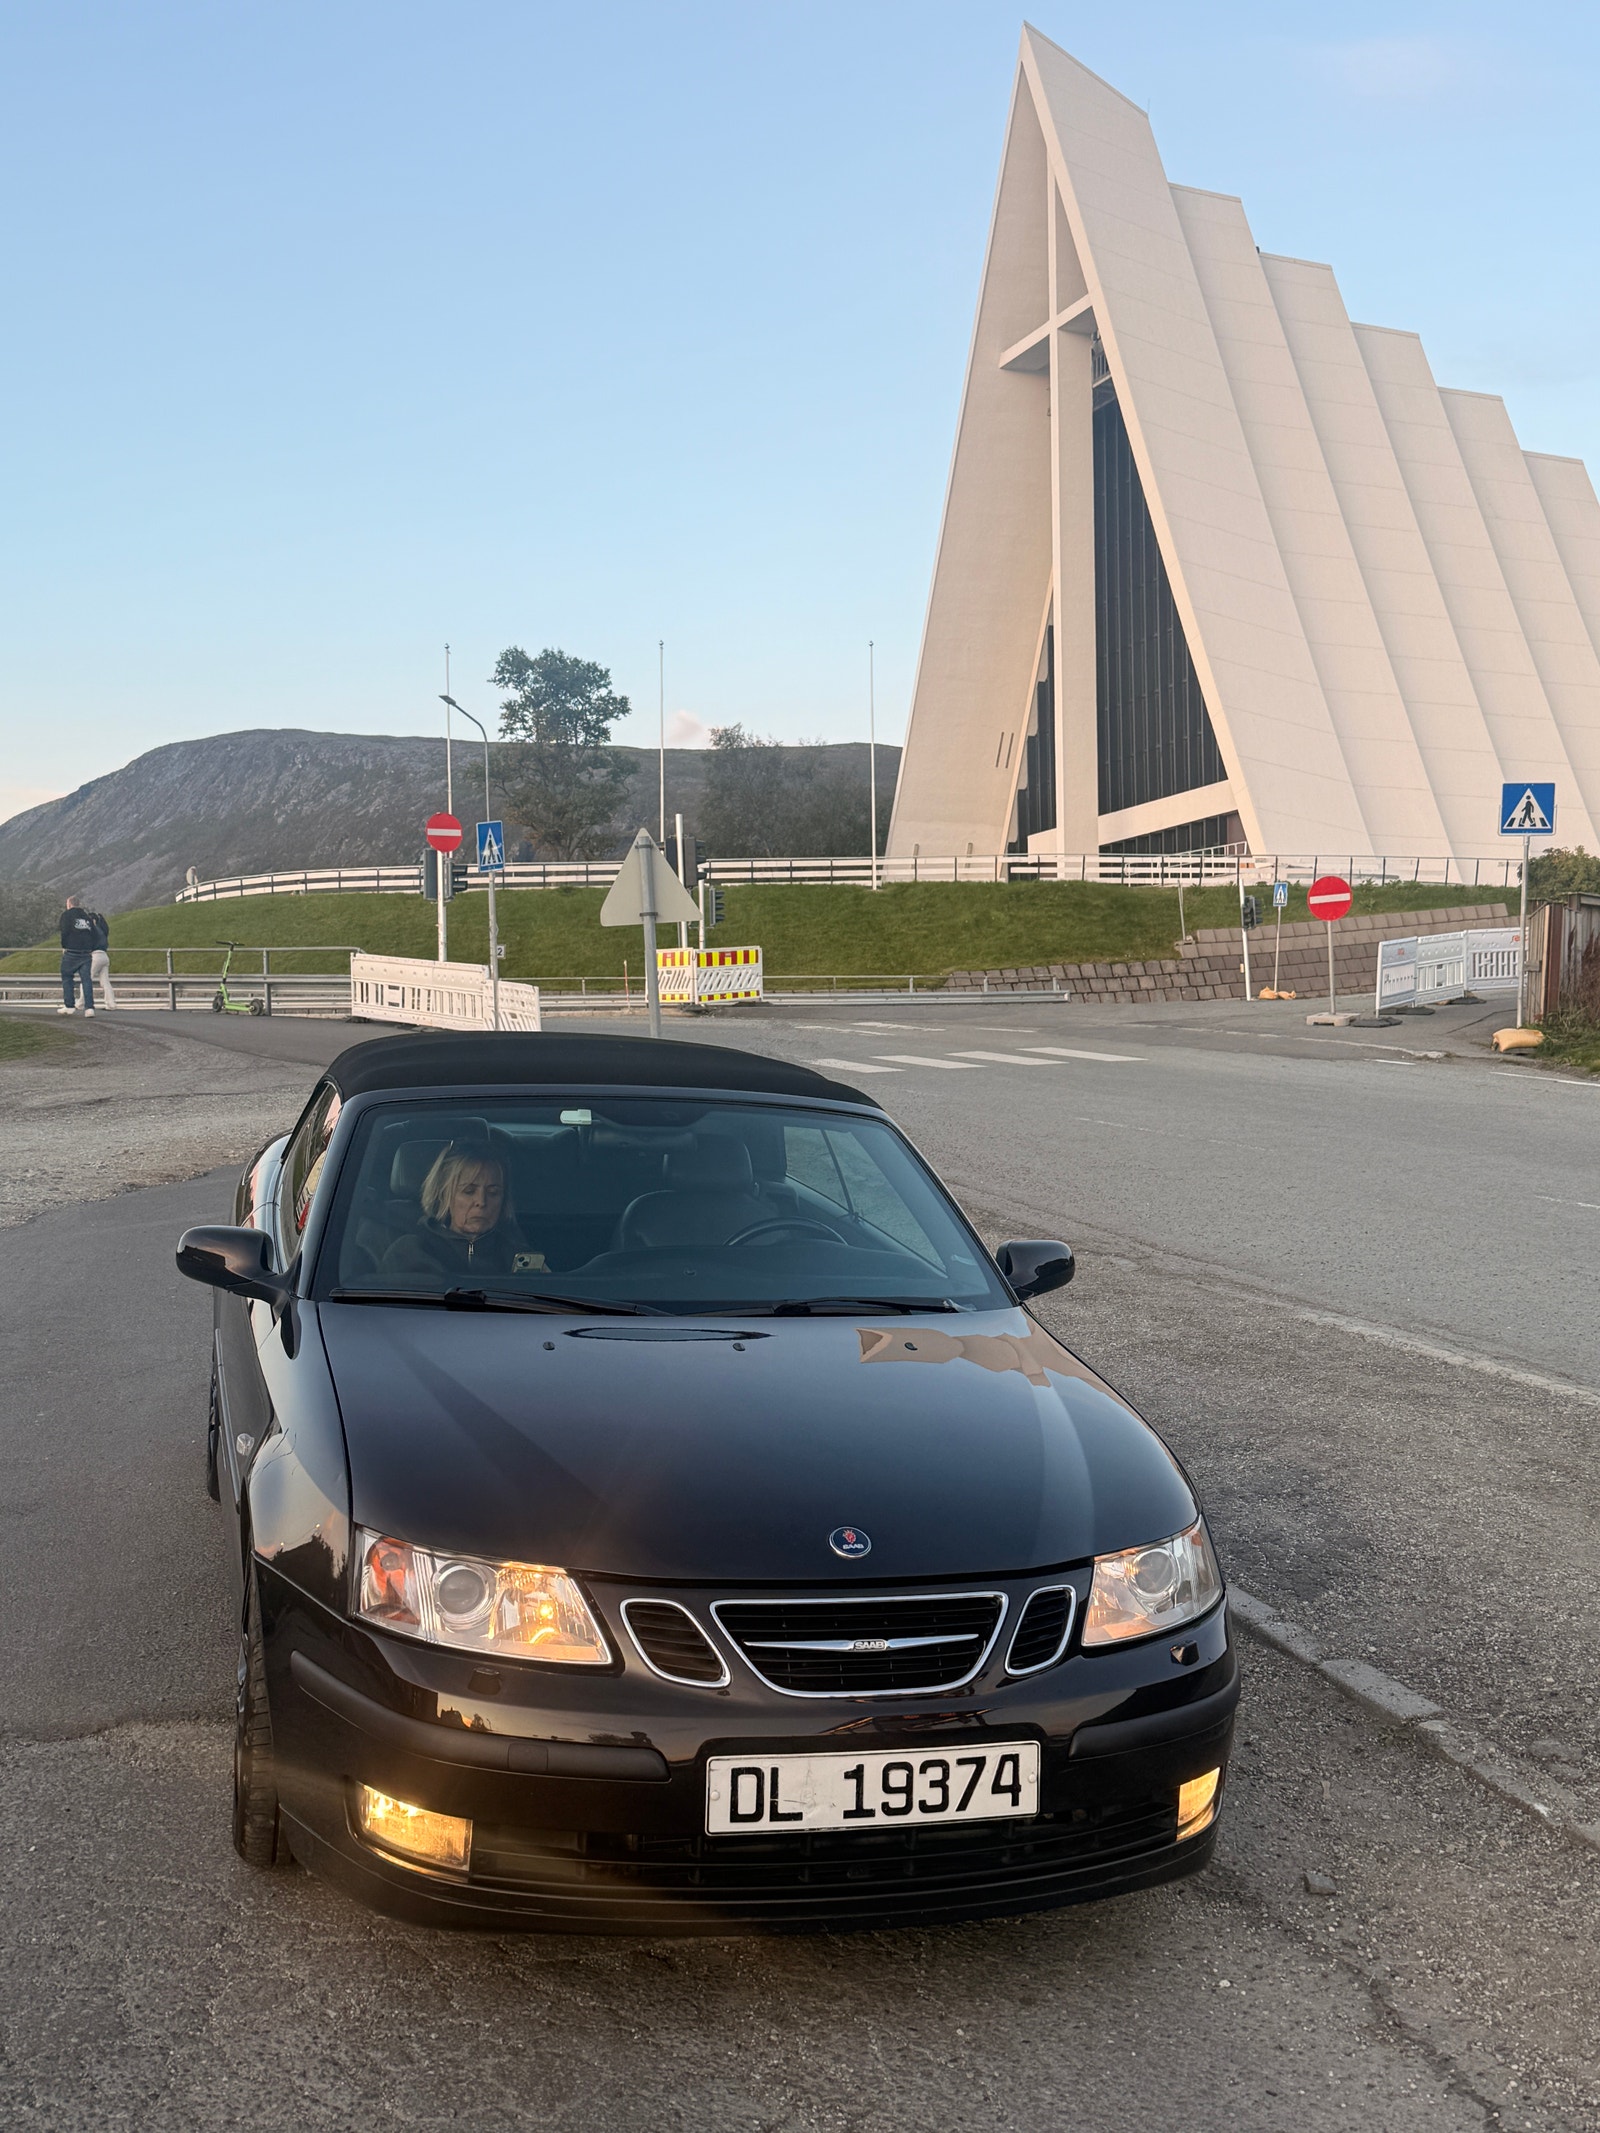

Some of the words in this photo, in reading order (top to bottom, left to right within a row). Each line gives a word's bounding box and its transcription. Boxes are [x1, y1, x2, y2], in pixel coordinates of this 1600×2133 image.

[855, 1641, 884, 1650] SAAB
[730, 1766, 803, 1823] DL
[843, 1753, 1022, 1820] 19374
